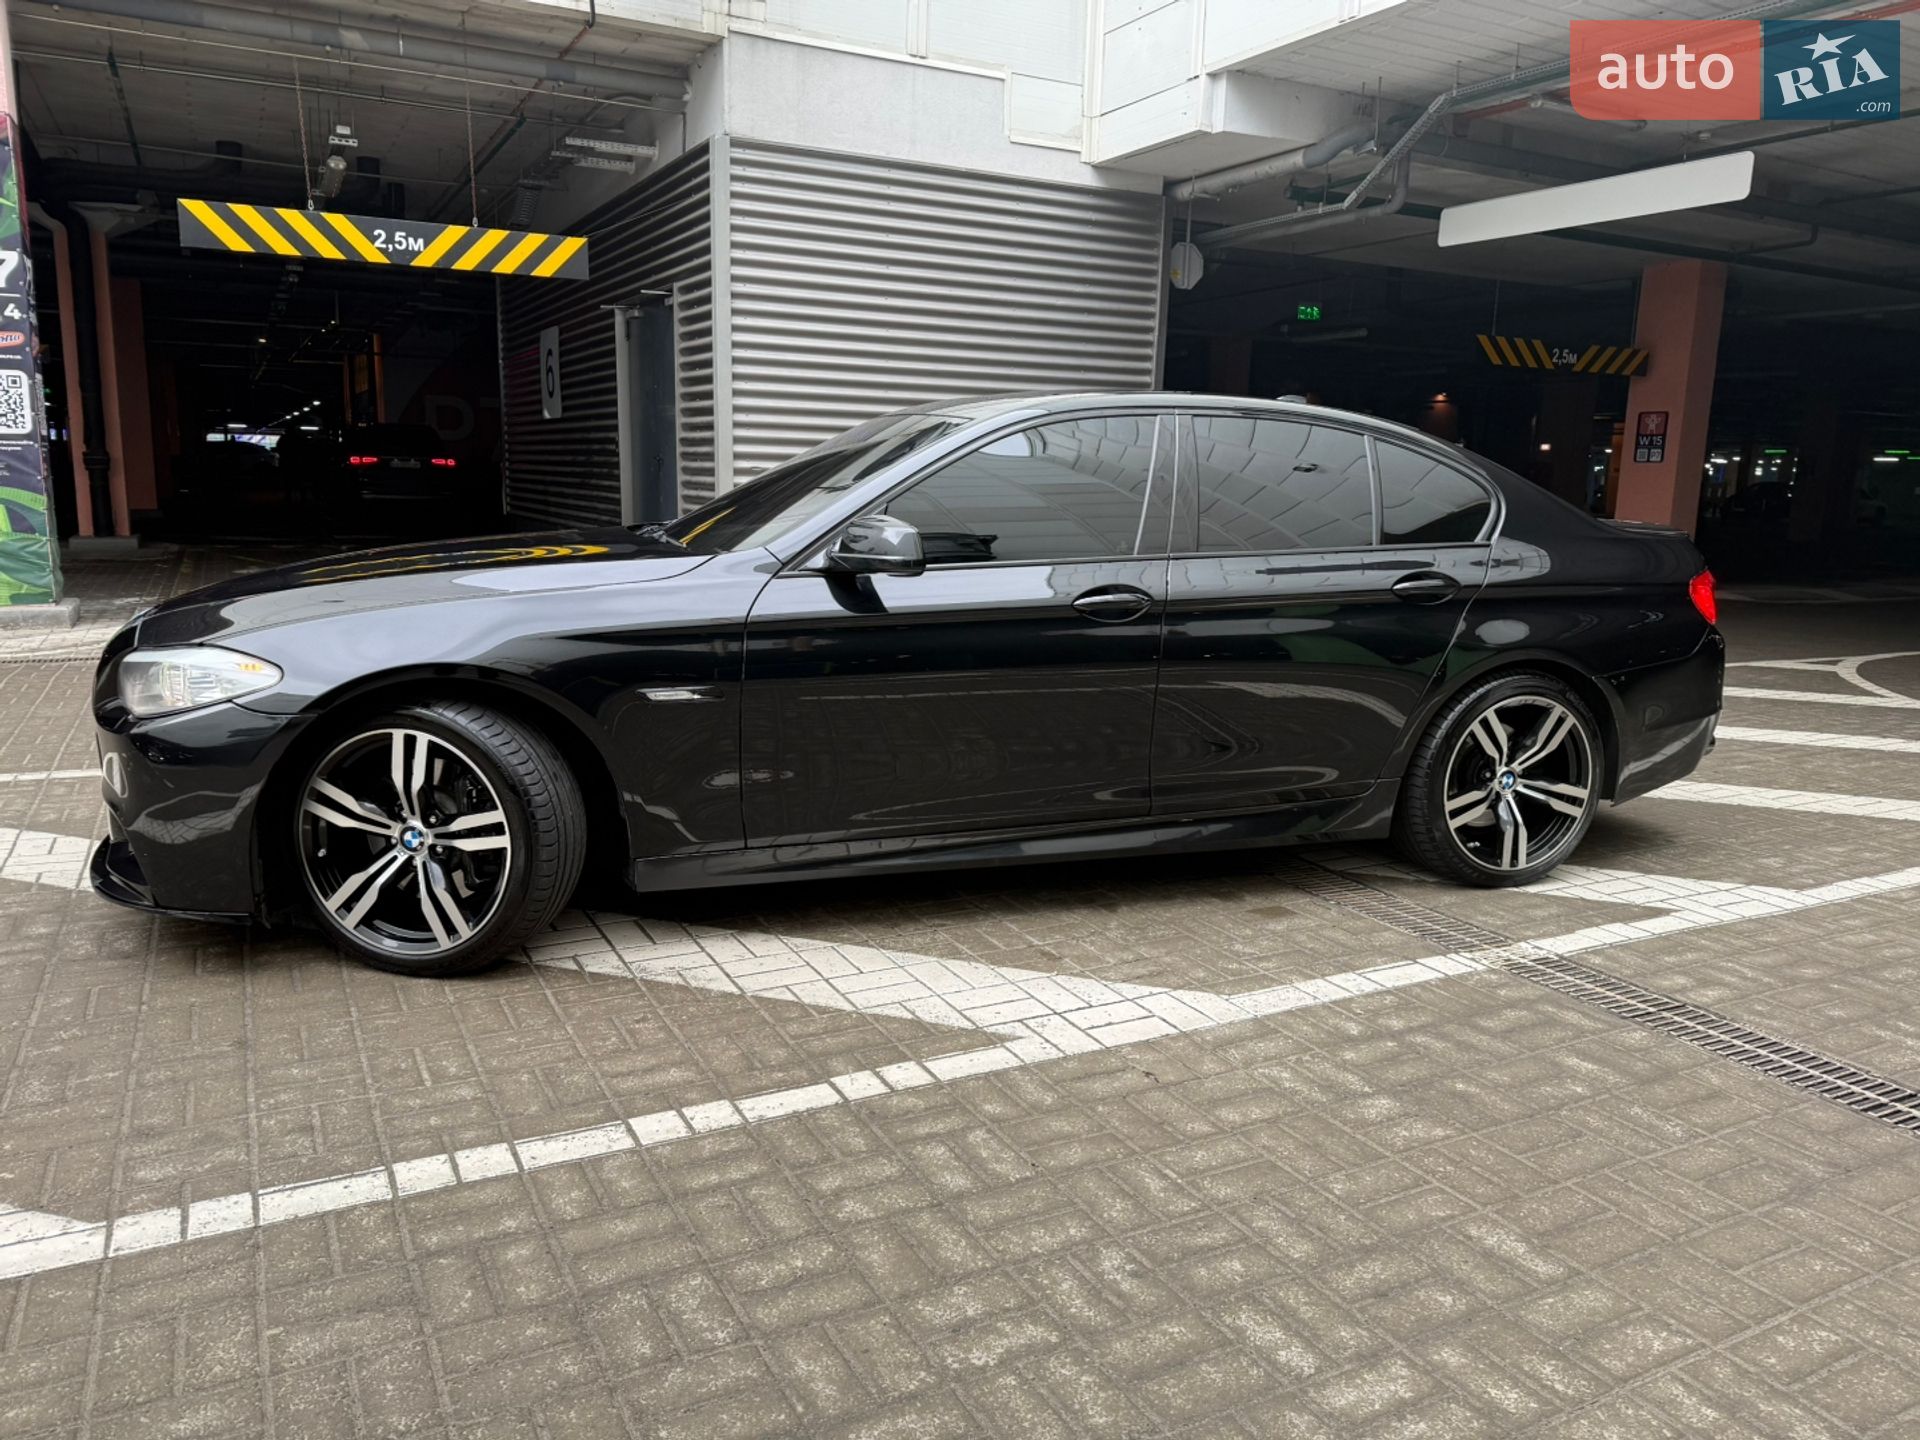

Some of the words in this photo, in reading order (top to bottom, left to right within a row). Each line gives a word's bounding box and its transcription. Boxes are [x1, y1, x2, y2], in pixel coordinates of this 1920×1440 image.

[545, 347, 555, 399] 6
[1639, 435, 1651, 446] W
[1652, 435, 1663, 446] 15
